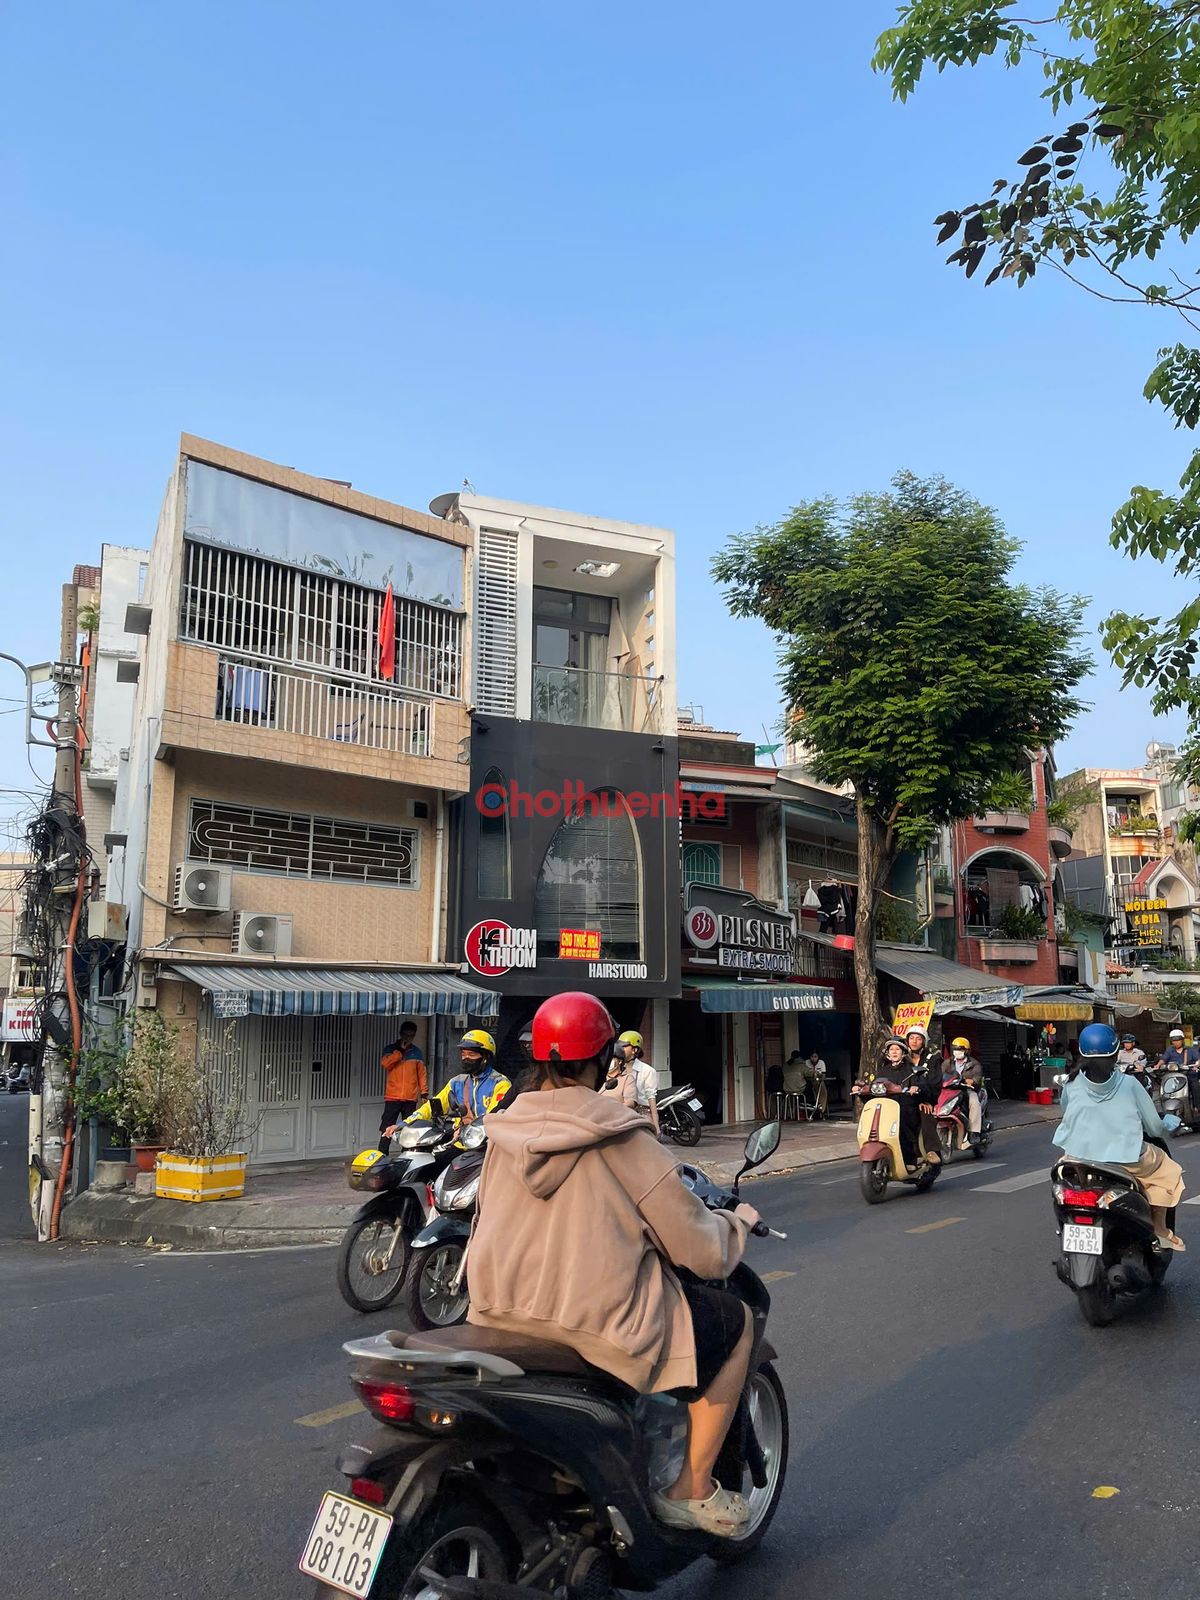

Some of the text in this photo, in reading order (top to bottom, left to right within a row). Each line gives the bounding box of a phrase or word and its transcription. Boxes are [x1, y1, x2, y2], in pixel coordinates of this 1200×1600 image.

[1141, 913, 1160, 924] BIA
[500, 927, 537, 948] LUOM
[718, 914, 793, 951] PILSNER
[488, 947, 537, 968] THUOM
[719, 948, 795, 973] EXTRA SMOOTH
[588, 963, 647, 979] HAIRSTUDIO
[773, 996, 790, 1010] 610
[9, 1020, 31, 1029] KIM
[1069, 1226, 1097, 1240] 59-SA
[1066, 1238, 1099, 1253] 218.54
[325, 1501, 379, 1552] 59-PA
[307, 1536, 372, 1591] 081.03
